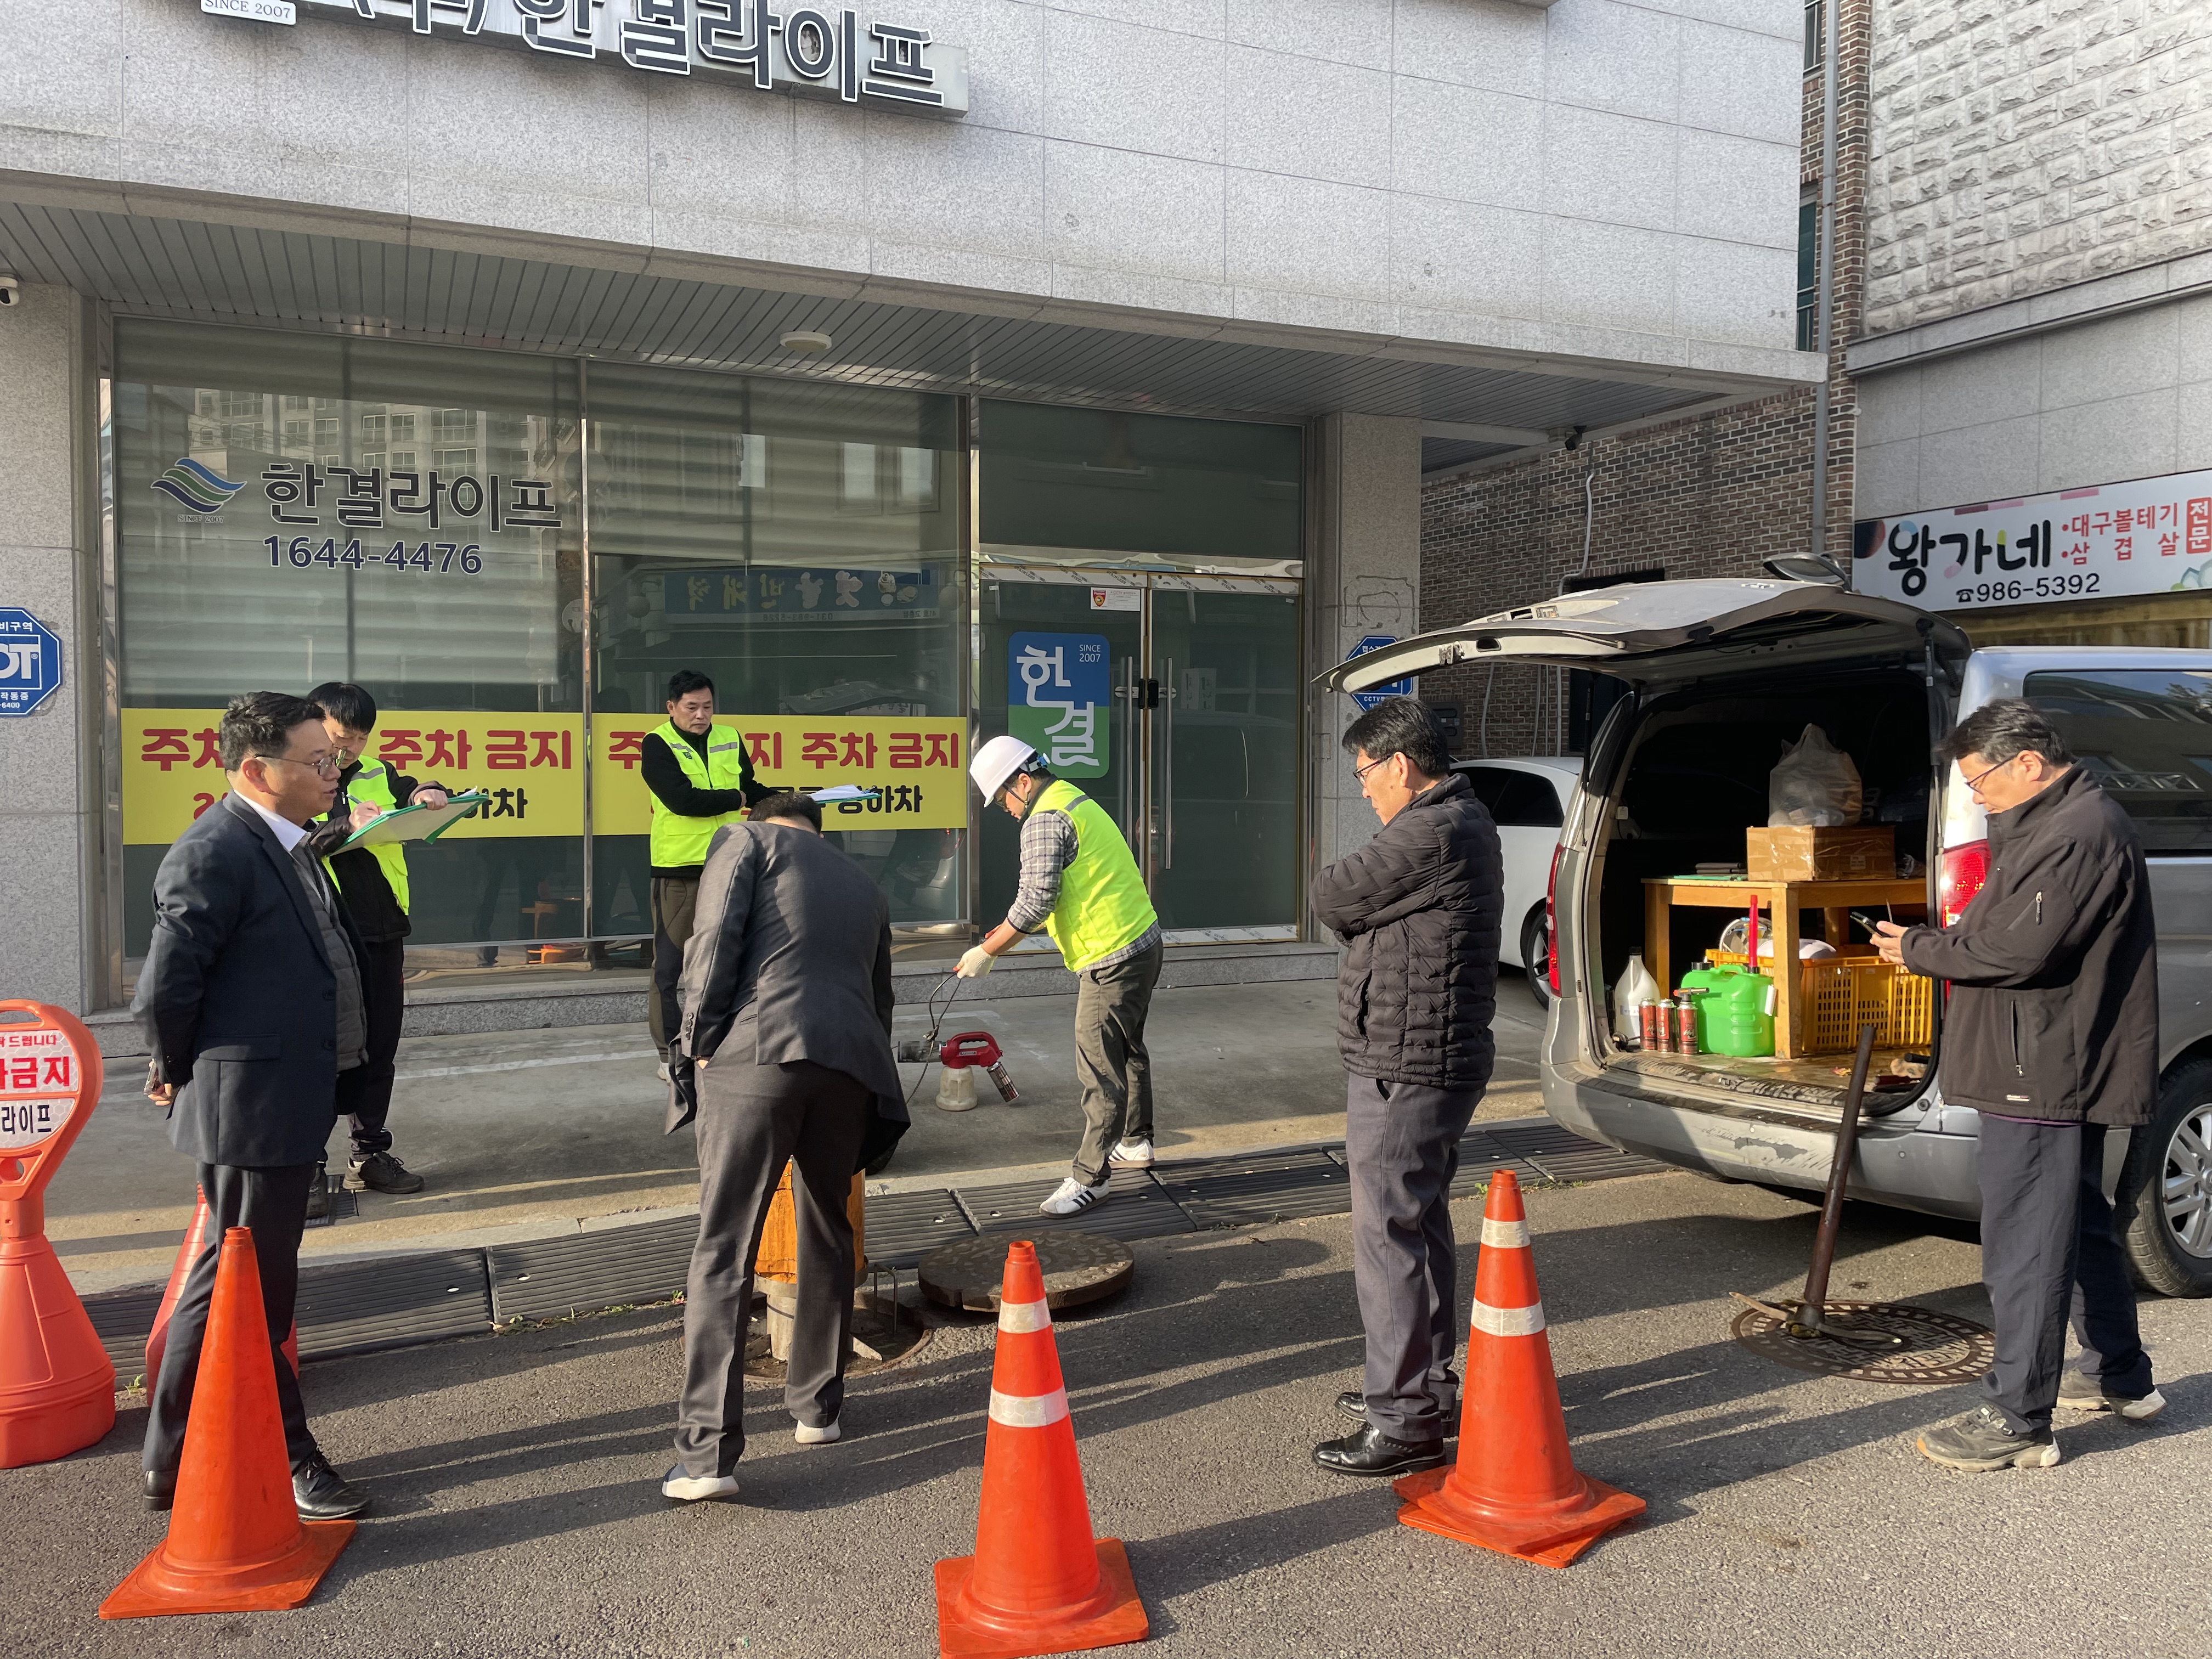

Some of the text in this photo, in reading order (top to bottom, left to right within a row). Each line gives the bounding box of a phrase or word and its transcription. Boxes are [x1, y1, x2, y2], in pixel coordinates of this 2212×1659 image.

[255, 3, 290, 18] 2007
[261, 462, 562, 532] 한결라이프
[178, 515, 224, 523] SINCE 2007
[263, 534, 483, 575] 1644-4476
[1888, 519, 2051, 596] 왕가네
[2071, 501, 2179, 538] 대구볼테기
[1977, 572, 2100, 602] 986-5392
[1079, 644, 1101, 652] SINCE
[1079, 653, 1101, 663] 2007
[379, 729, 472, 770] 주차
[486, 729, 572, 770] 금지
[802, 732, 878, 769] 주차
[889, 733, 959, 769] 금지
[9, 1035, 57, 1047] 드립니다
[1, 1104, 52, 1135] 라이프
